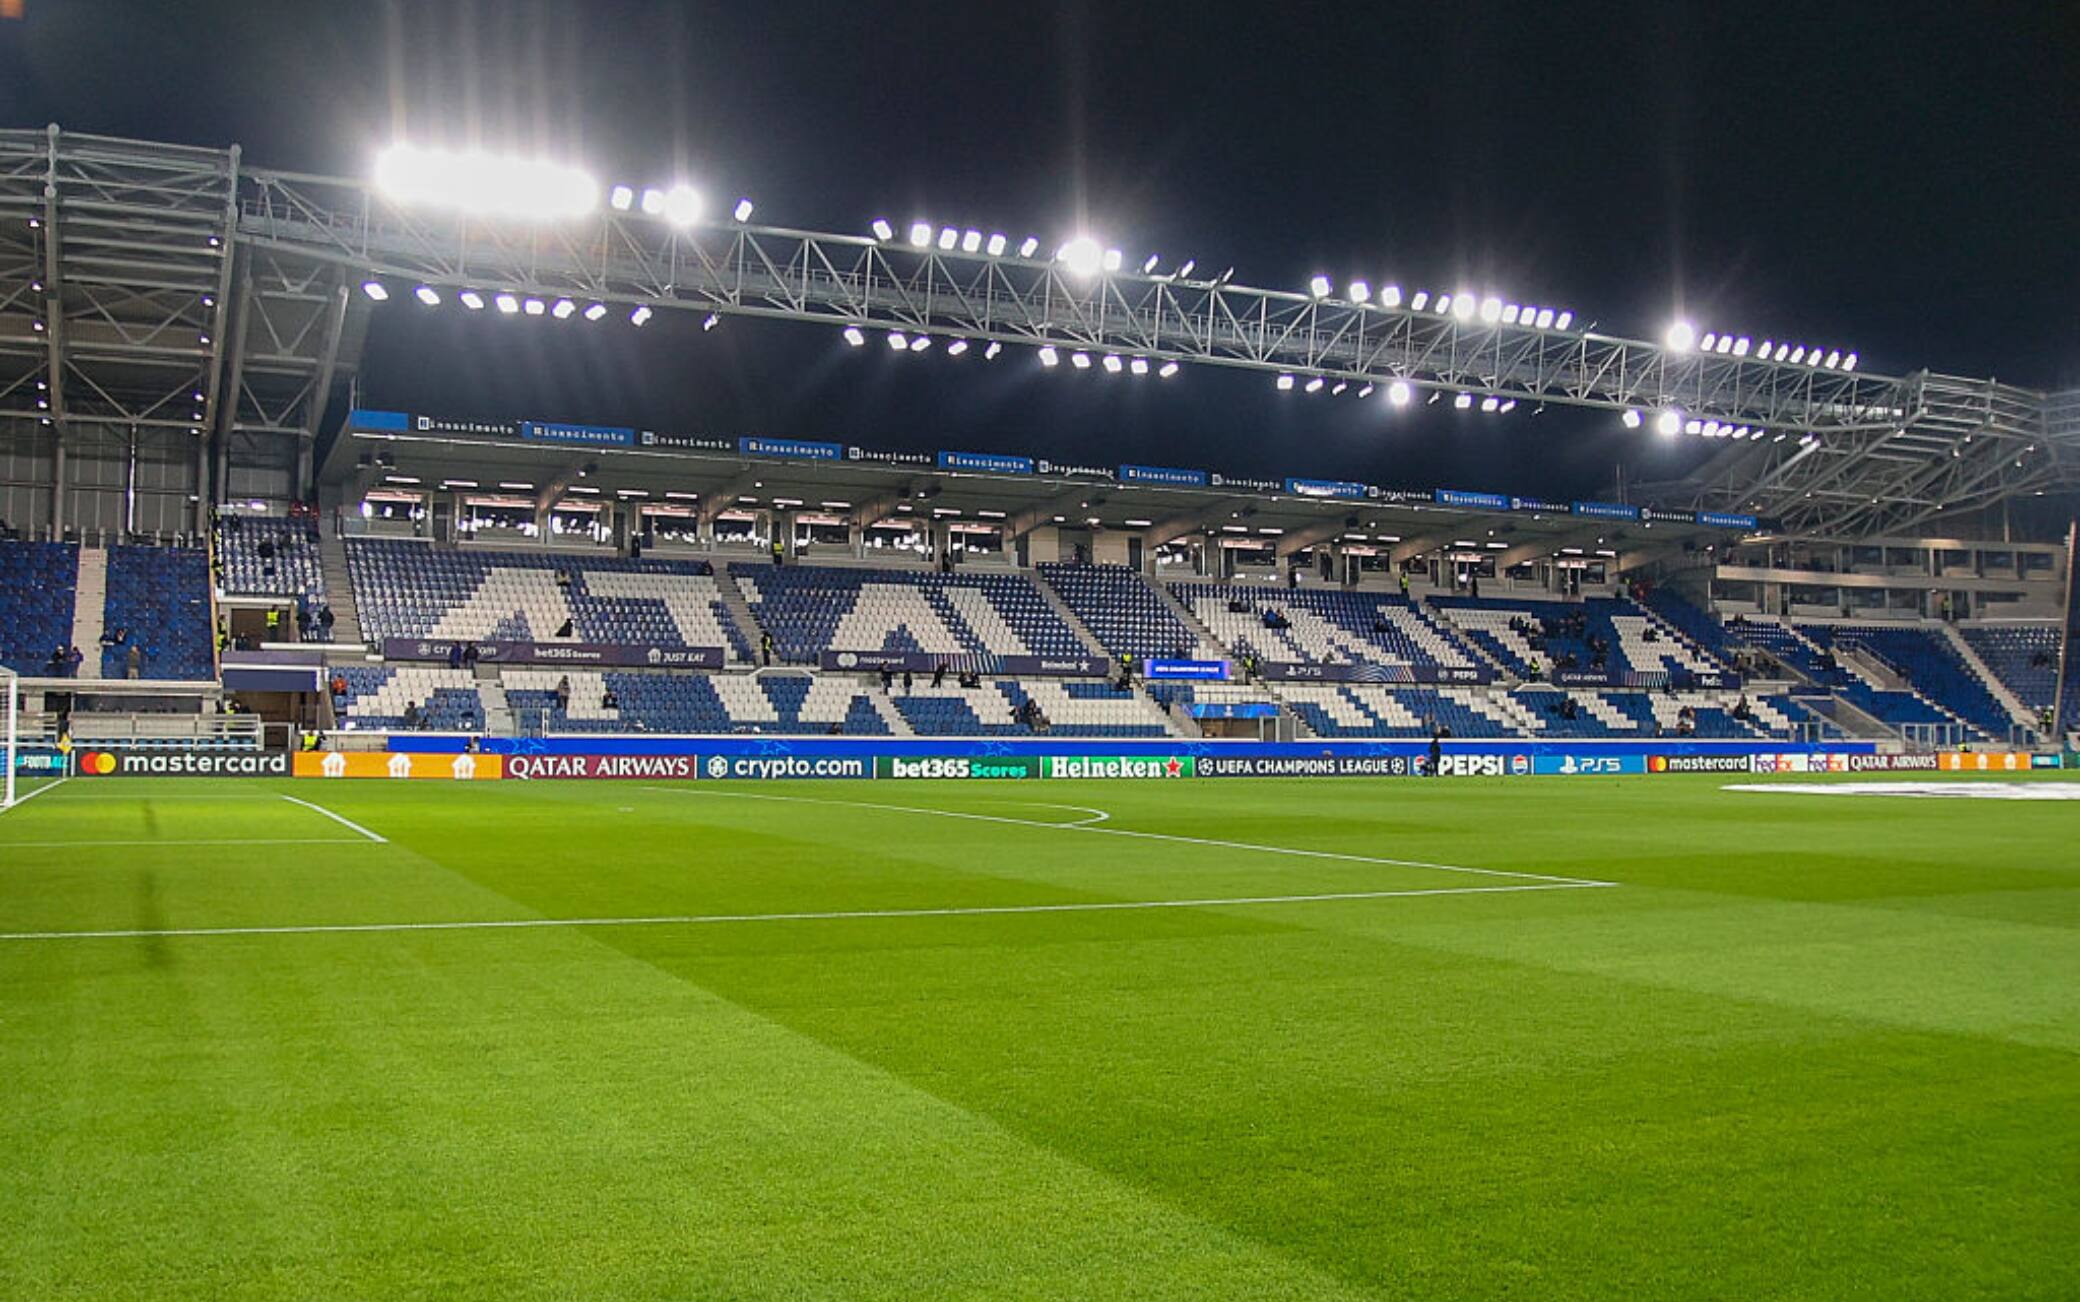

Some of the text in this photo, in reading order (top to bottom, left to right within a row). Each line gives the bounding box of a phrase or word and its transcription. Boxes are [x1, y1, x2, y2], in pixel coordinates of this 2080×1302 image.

[123, 753, 286, 773] mastercard
[509, 756, 690, 779] QATAR AIRWAYS
[735, 756, 862, 779] crypto.com
[1052, 757, 1162, 778] Heineken
[1216, 760, 1389, 773] UEFA CHAMPIONS LEAGUE
[1438, 755, 1504, 776] PEPSI
[1581, 758, 1621, 772] PS5
[1668, 756, 1748, 771] mastercard
[1850, 755, 1937, 771] QATAR AIRWAYS
